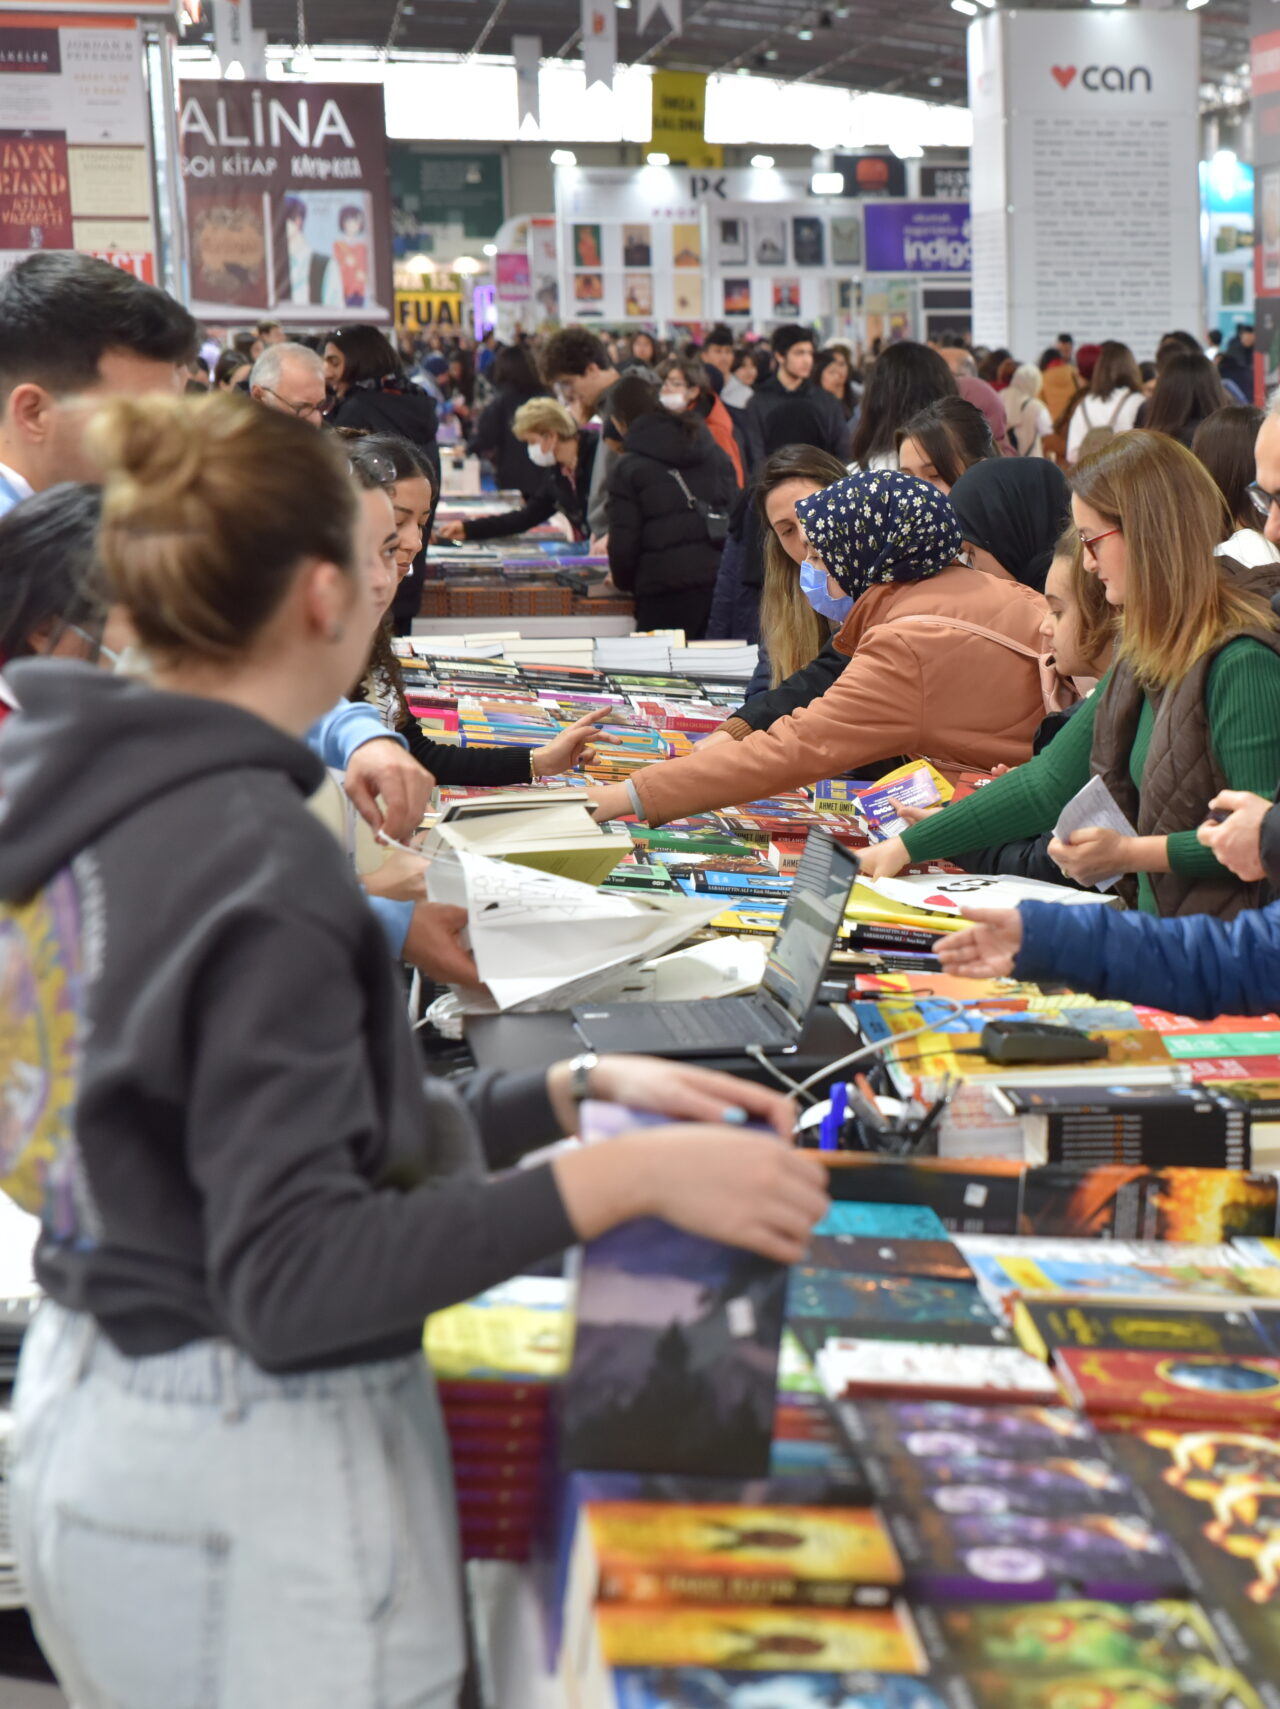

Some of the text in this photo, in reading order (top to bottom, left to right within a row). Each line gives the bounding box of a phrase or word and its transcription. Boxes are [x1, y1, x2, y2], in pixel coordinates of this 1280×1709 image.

[1081, 65, 1152, 92] can
[221, 153, 279, 177] KİTAP
[818, 800, 854, 813] AHMET ÜMİT
